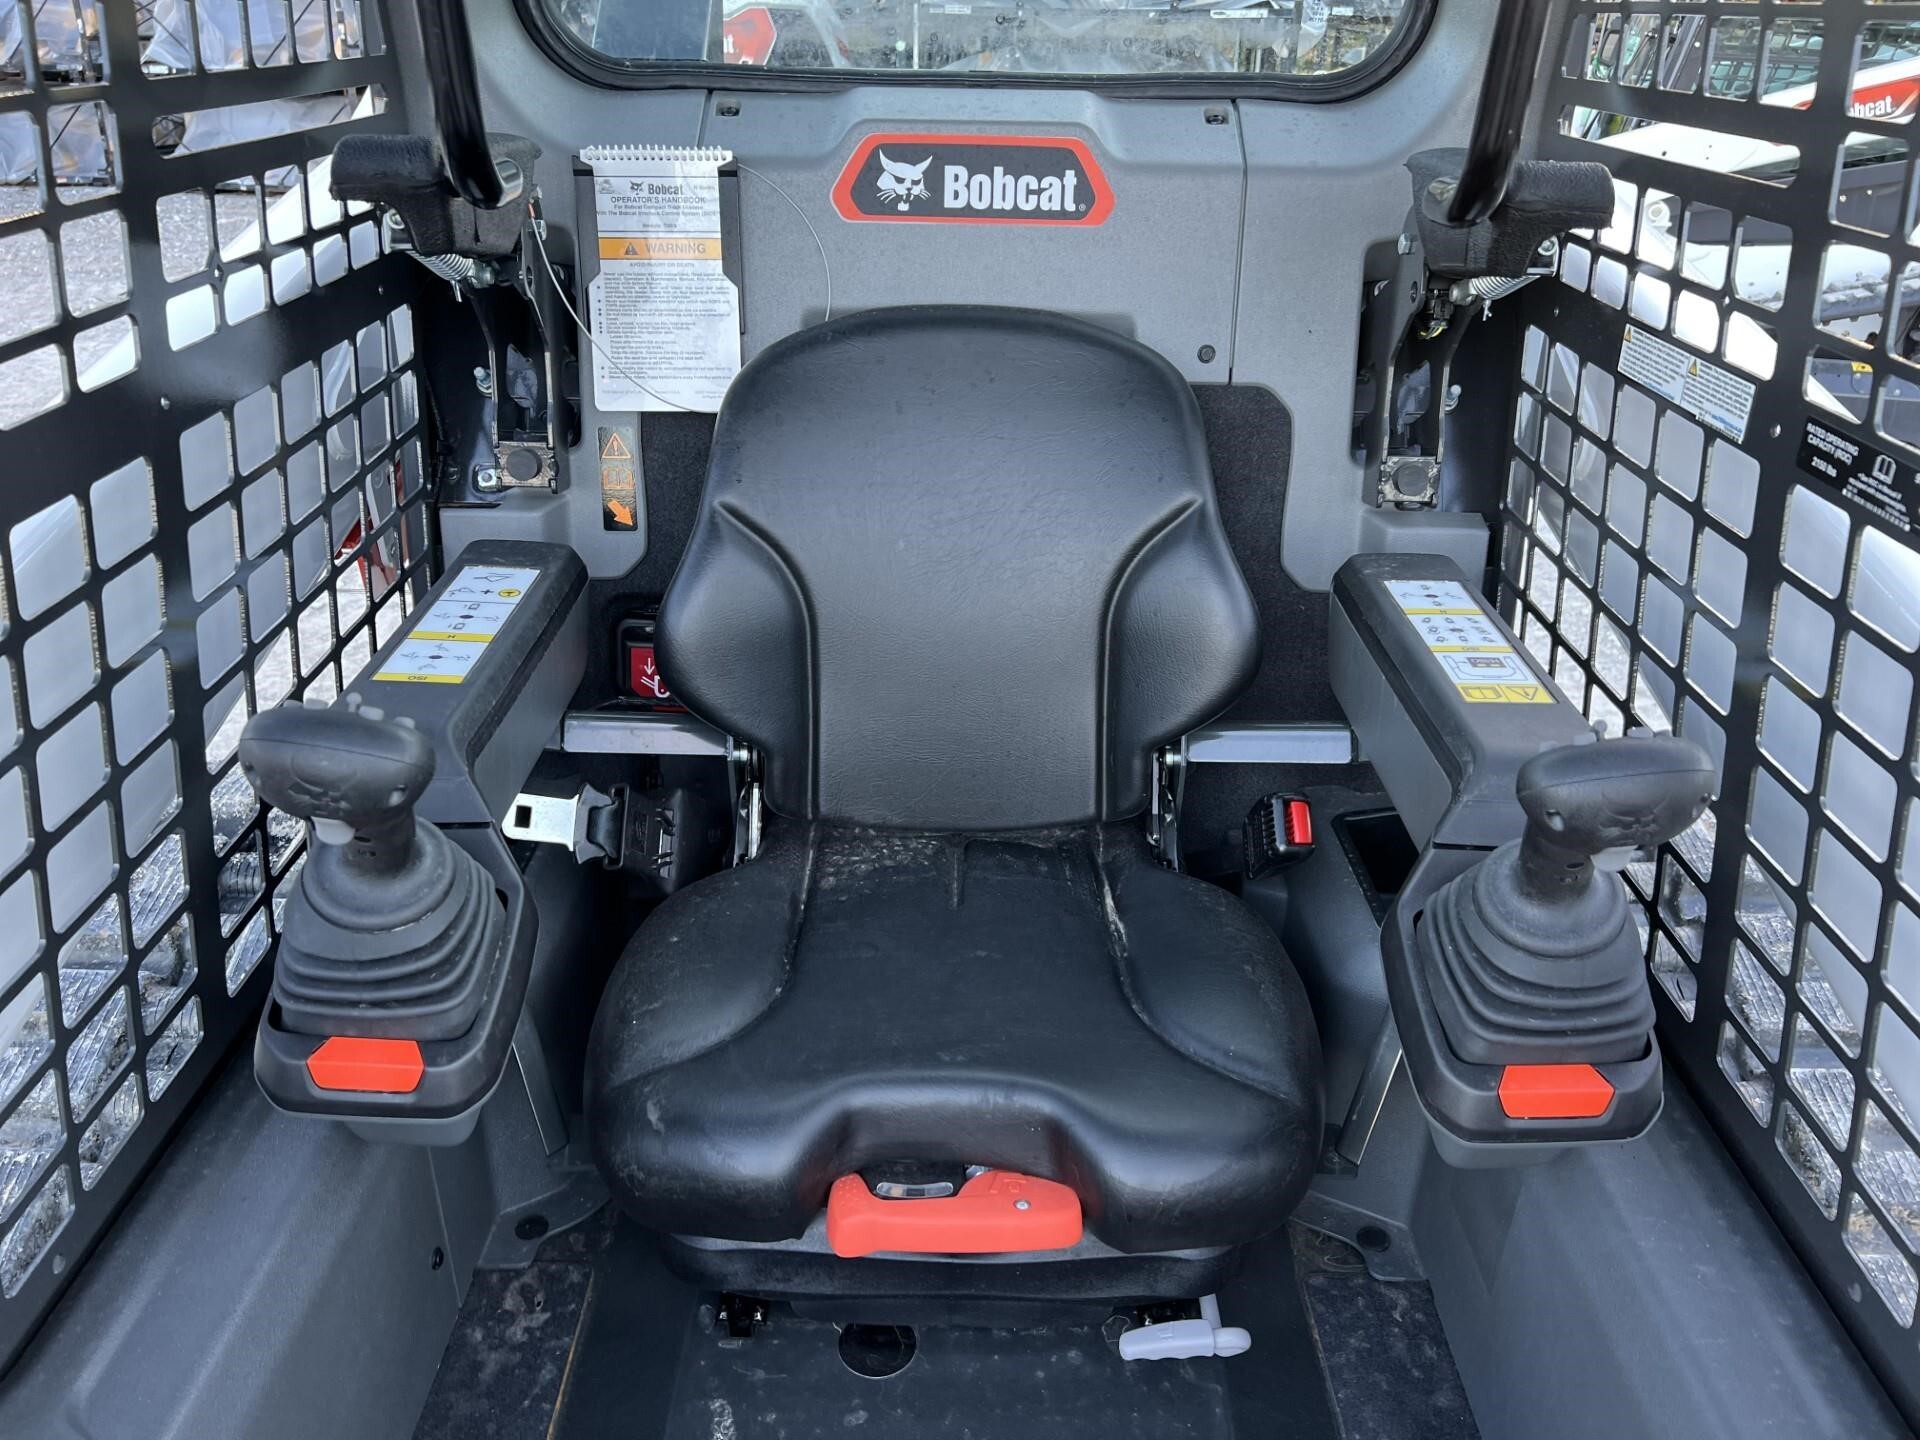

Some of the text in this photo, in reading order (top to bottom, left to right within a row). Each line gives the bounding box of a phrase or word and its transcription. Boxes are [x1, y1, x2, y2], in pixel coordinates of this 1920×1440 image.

[1848, 95, 1893, 117] bcat
[648, 183, 684, 195] Bobcat
[943, 164, 1077, 212] Bobcat
[610, 196, 706, 204] OPERATOR'S HANDBOOK
[645, 243, 706, 254] WARNING
[1806, 422, 1860, 457] RATED OPERATING
[1807, 433, 1836, 454] CAPACITY
